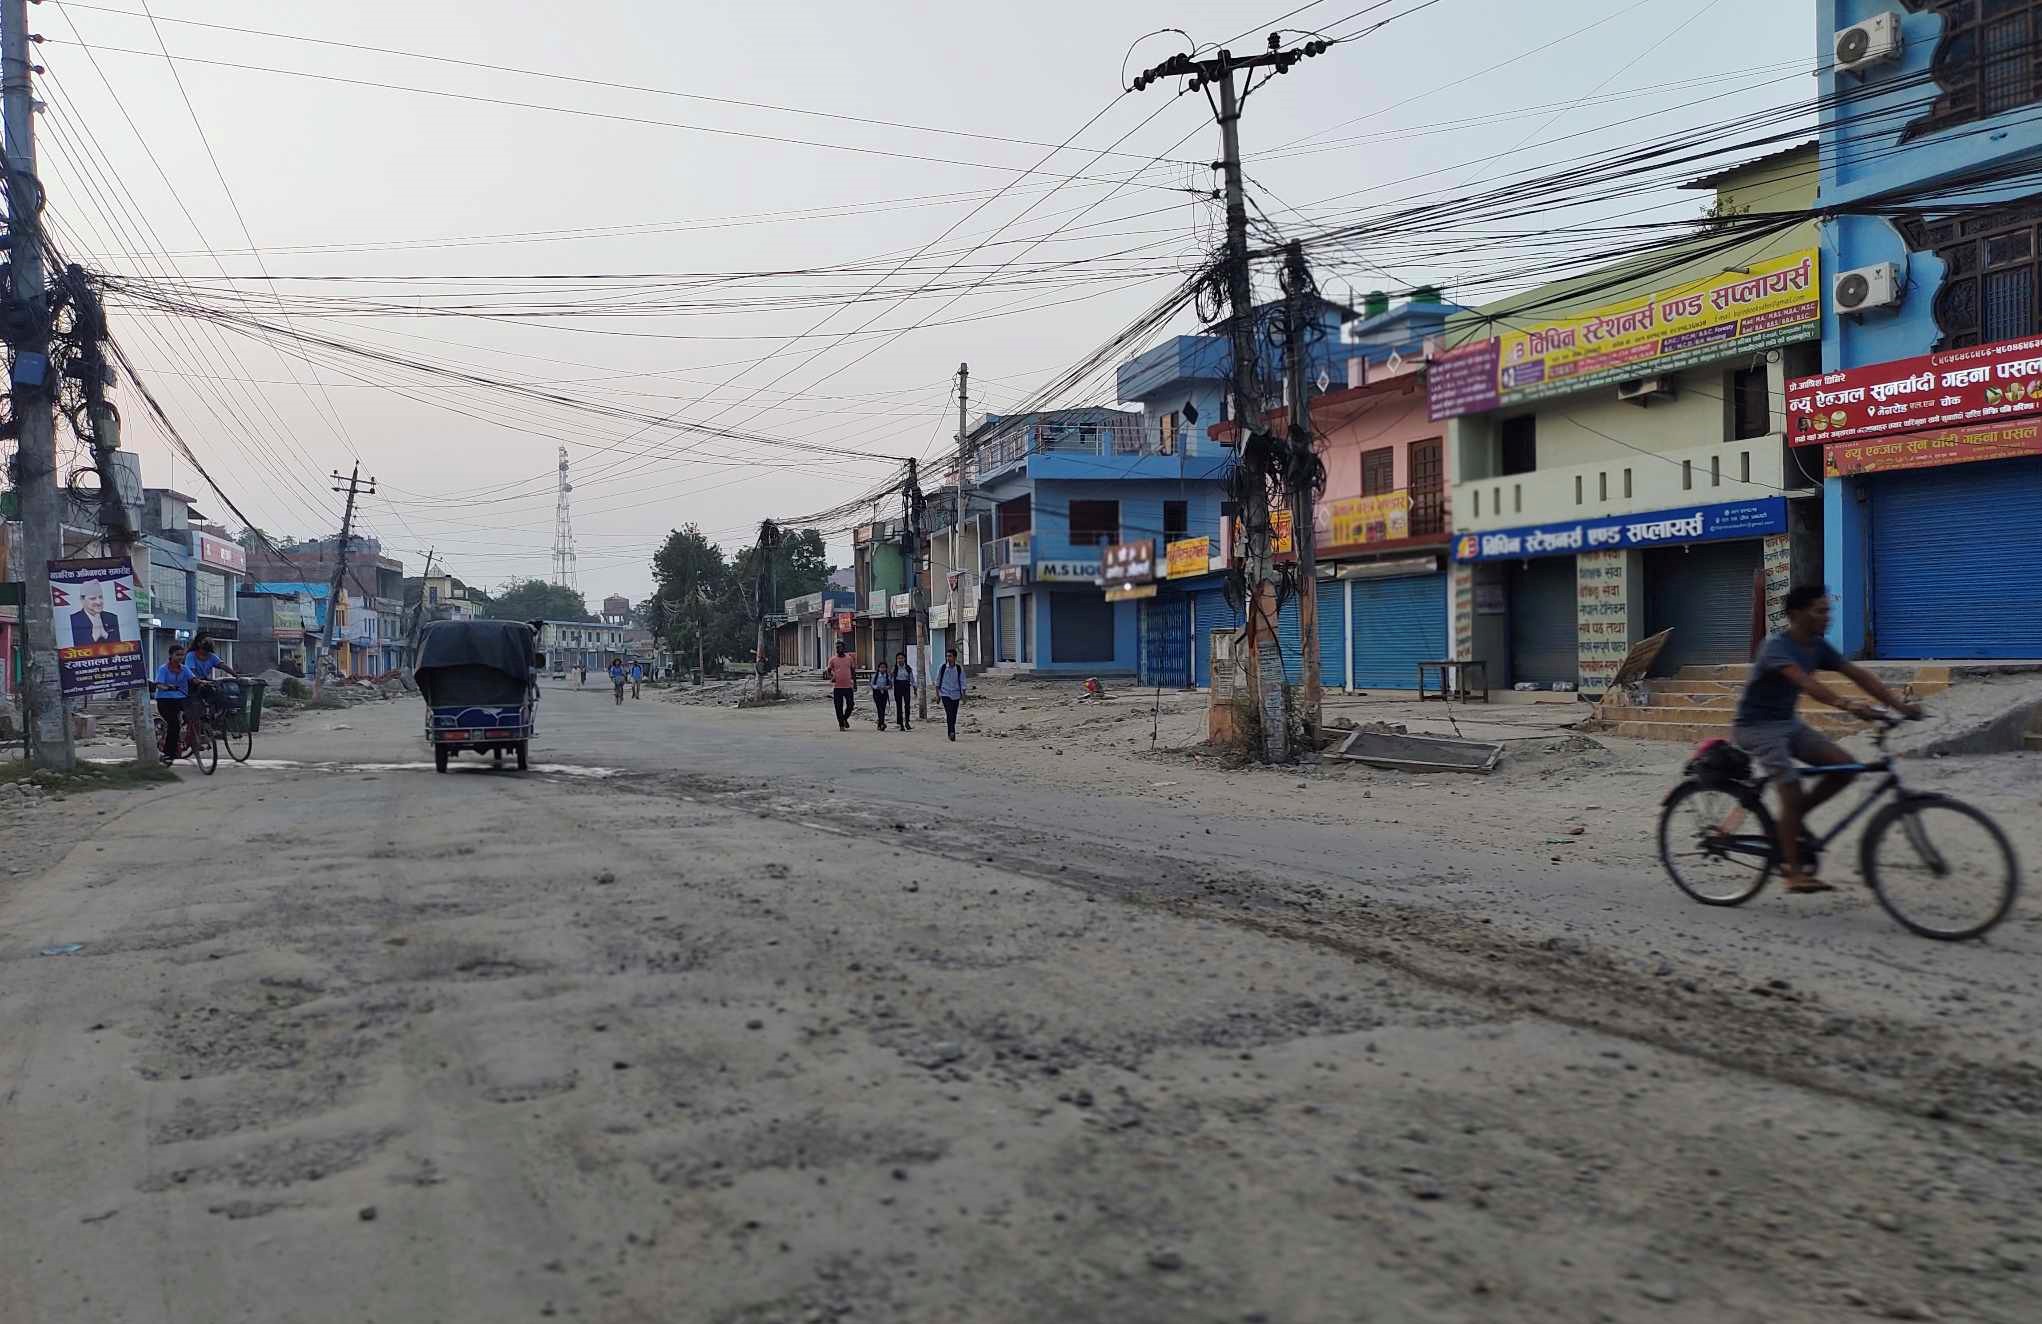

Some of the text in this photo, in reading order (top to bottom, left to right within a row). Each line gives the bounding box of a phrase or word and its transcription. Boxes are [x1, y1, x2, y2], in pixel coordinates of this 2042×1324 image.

[1529, 328, 1576, 356] विपिन
[1583, 303, 1655, 344] स्टेशनर्स
[1662, 293, 1704, 322] एण्ड
[1711, 257, 1811, 310] सप्लायर्स
[1789, 396, 1813, 413] न्यू
[1815, 387, 1865, 408] ऐन्जल
[1941, 366, 1991, 388] गहना
[1996, 357, 2042, 379] पसल
[1962, 431, 1998, 444] गहना
[2003, 426, 2038, 440] पसल
[1587, 524, 1621, 546] एण्ड
[1627, 512, 1704, 543] सप्लायर्स
[1043, 564, 1069, 576] M.S
